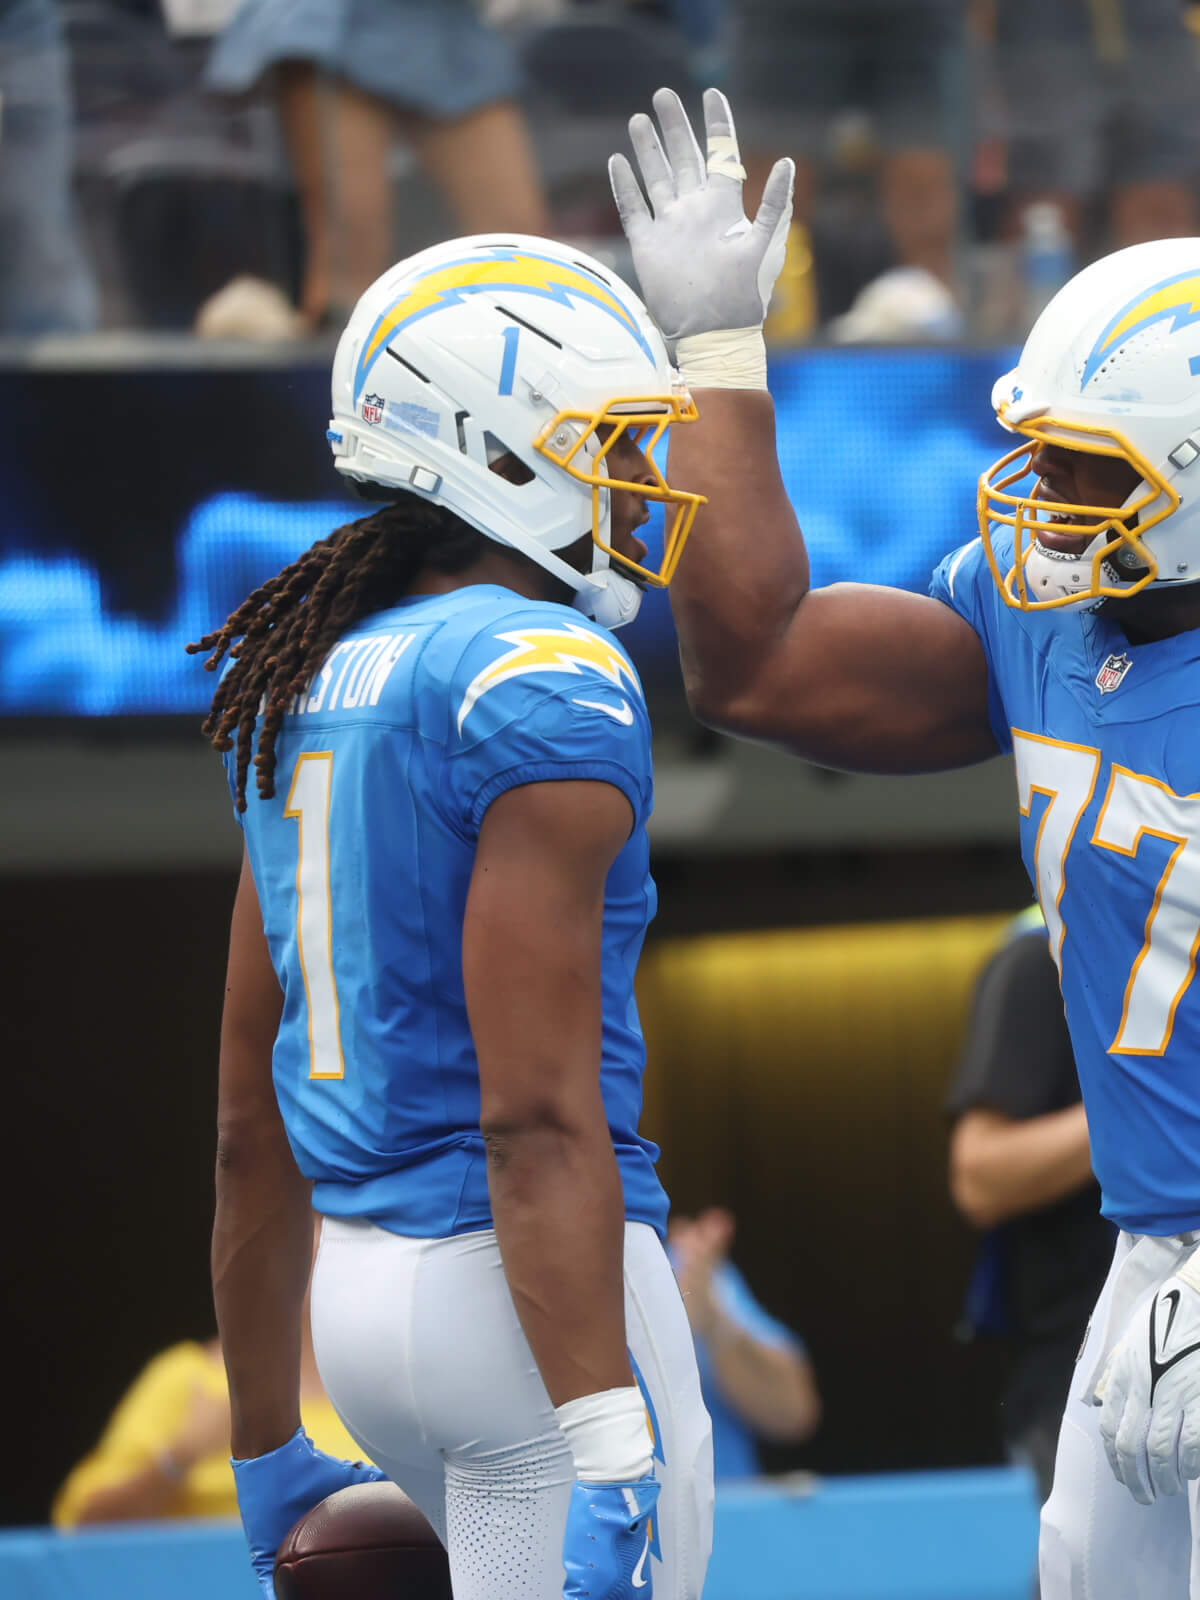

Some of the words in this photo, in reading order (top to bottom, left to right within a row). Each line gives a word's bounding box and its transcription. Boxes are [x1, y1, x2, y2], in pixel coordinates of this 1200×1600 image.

[498, 326, 520, 396] 1
[363, 405, 381, 422] NFL
[257, 633, 417, 716] STON
[1099, 668, 1121, 687] NFL
[283, 750, 345, 1080] 1
